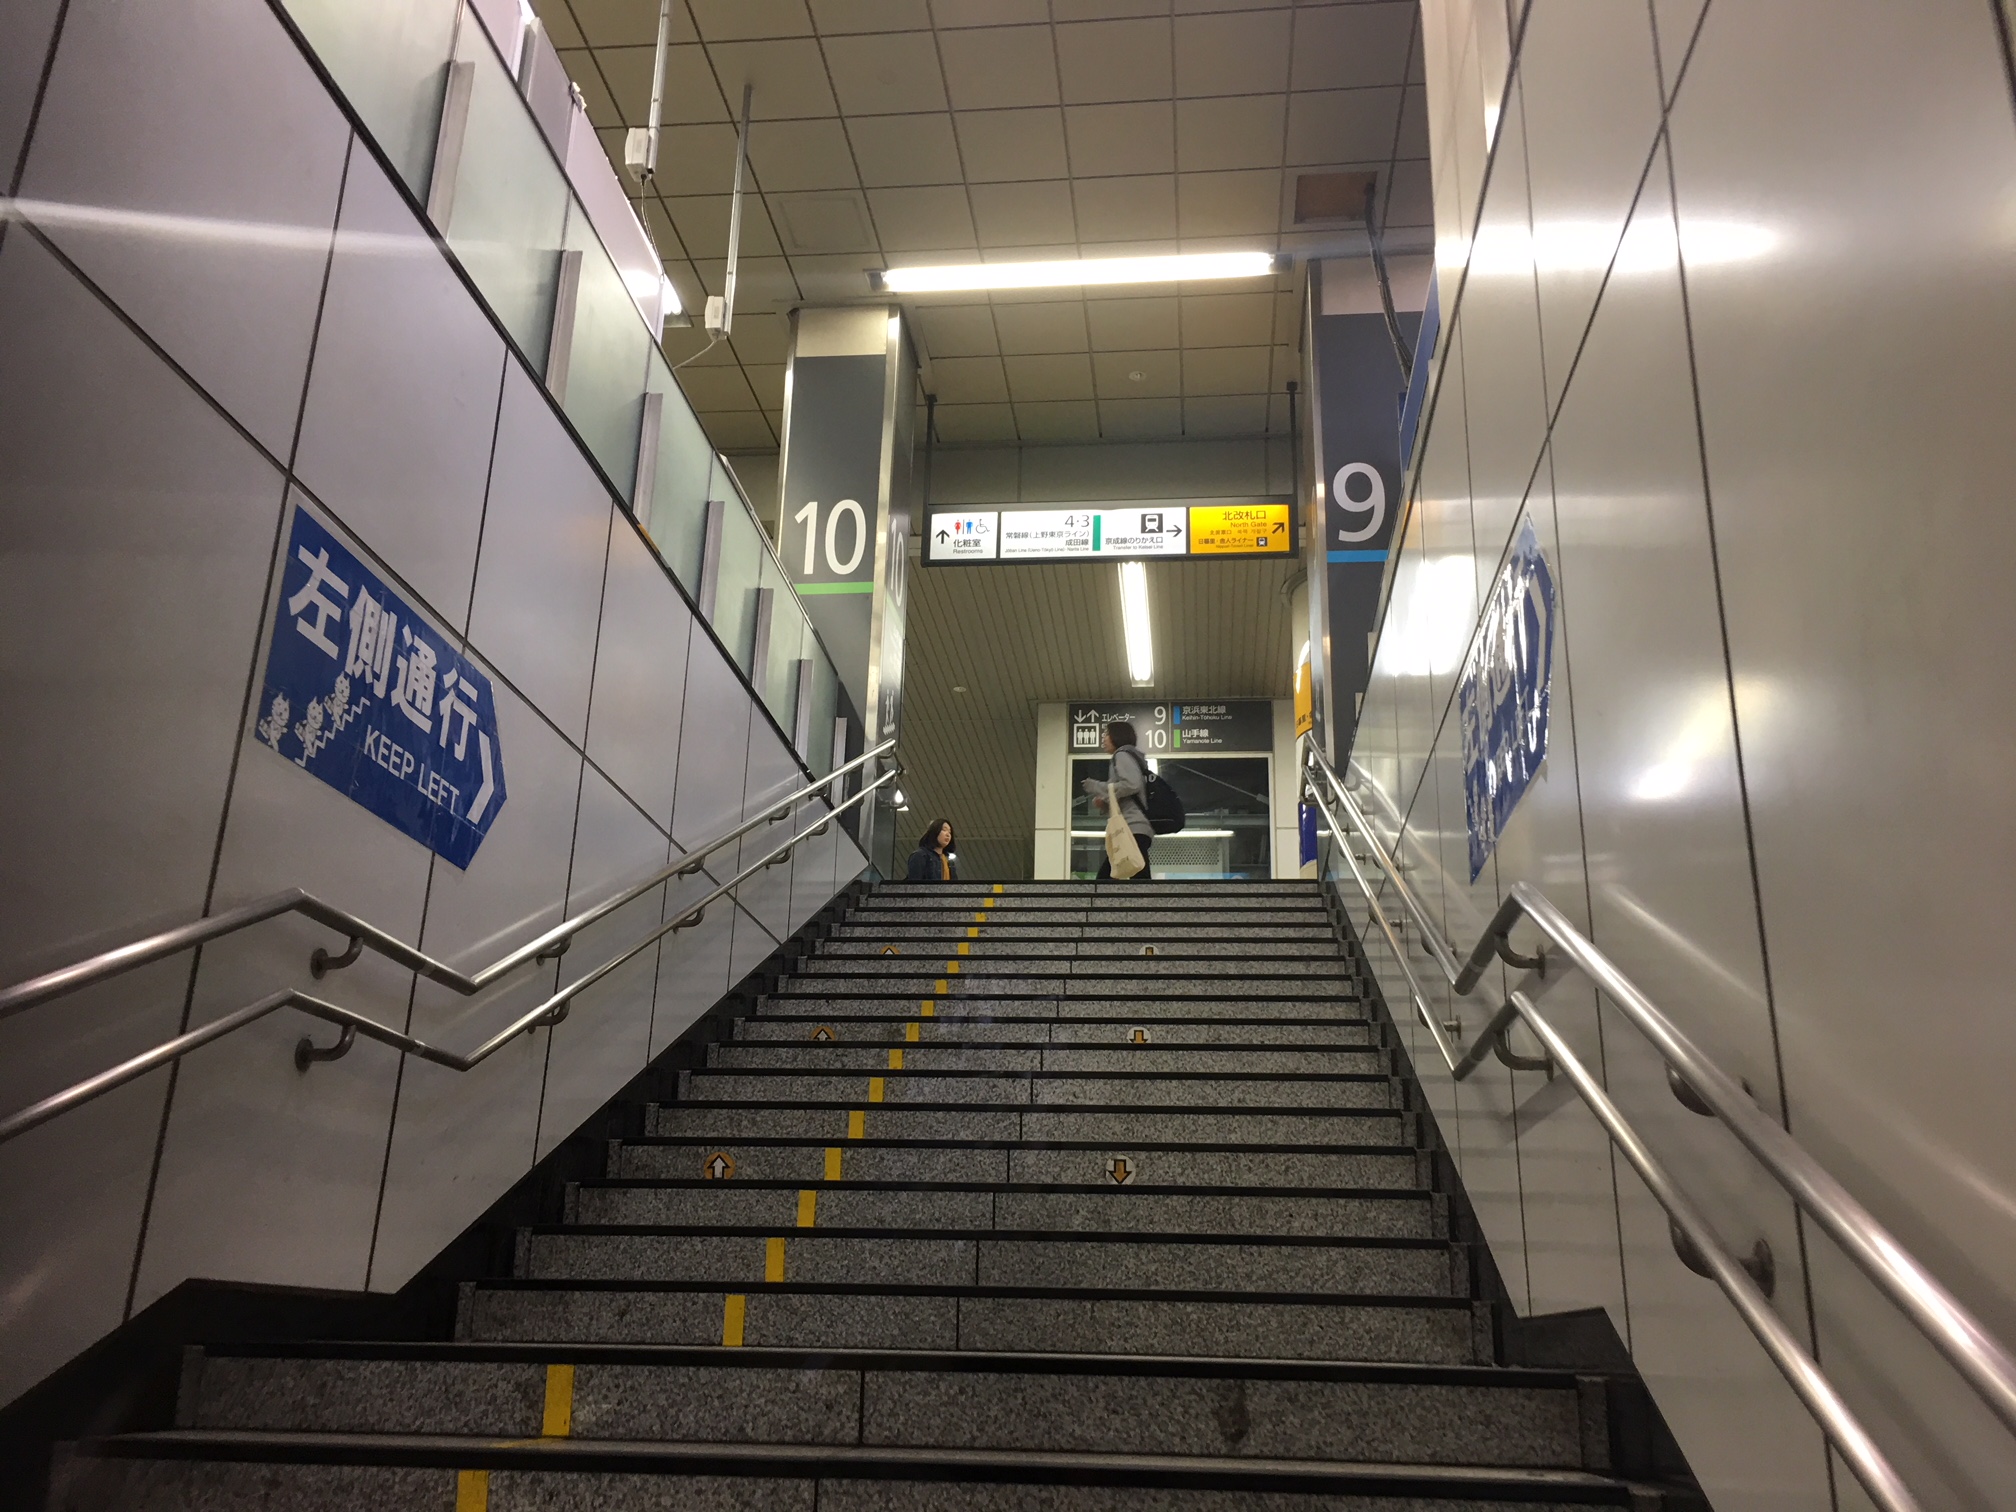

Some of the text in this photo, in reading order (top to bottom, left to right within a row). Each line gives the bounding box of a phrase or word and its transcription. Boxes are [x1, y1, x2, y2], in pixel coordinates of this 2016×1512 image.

[1332, 462, 1386, 543] 9
[1222, 510, 1267, 521] 北改札口
[794, 499, 867, 575] 10
[953, 539, 981, 548] 化粧室
[1065, 538, 1089, 546] 成田線
[1105, 536, 1164, 545] 京成線のりかえ口
[890, 518, 905, 607] 10
[287, 544, 479, 762] 左側通行
[1154, 706, 1166, 725] 9
[1182, 705, 1226, 714] 京浜東北線
[1102, 713, 1136, 722] エレベーター
[1145, 729, 1167, 749] 10
[1182, 729, 1209, 738] 山手線
[363, 724, 461, 815] KEEP LEFT
